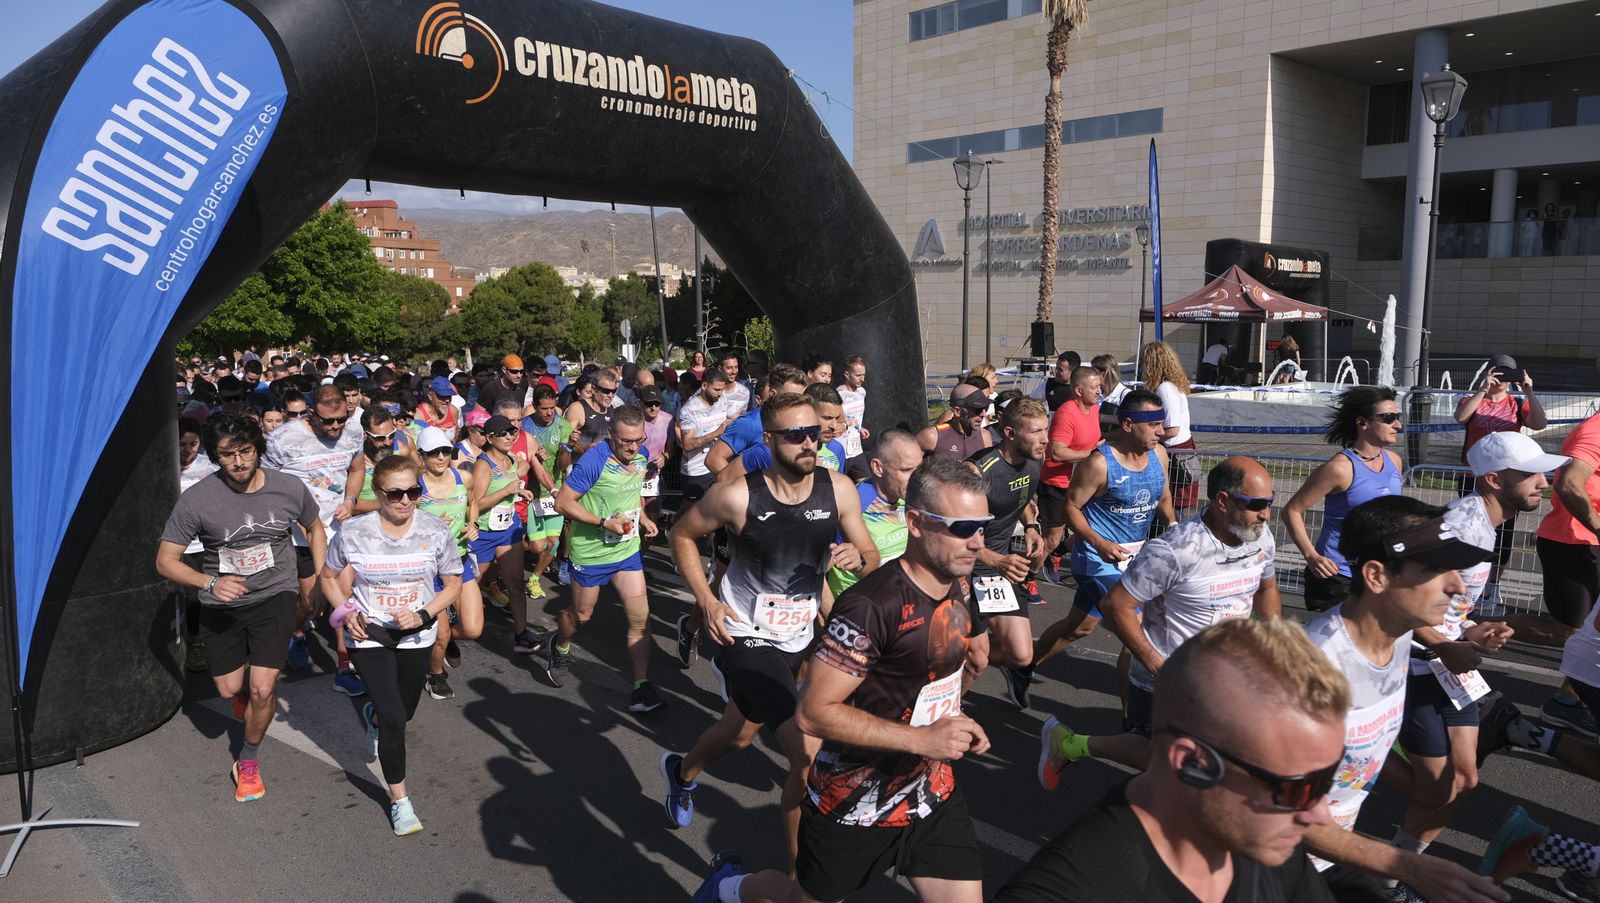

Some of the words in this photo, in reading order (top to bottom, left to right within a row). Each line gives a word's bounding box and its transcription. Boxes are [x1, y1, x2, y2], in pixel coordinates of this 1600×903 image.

[600, 95, 695, 124] cronometraje
[698, 109, 757, 132] deportivo
[155, 103, 278, 292] centrohogarsanchez.es
[1008, 475, 1030, 490] TRG
[376, 591, 418, 608] 1058
[985, 588, 1006, 600] 181
[766, 609, 811, 626] 1254
